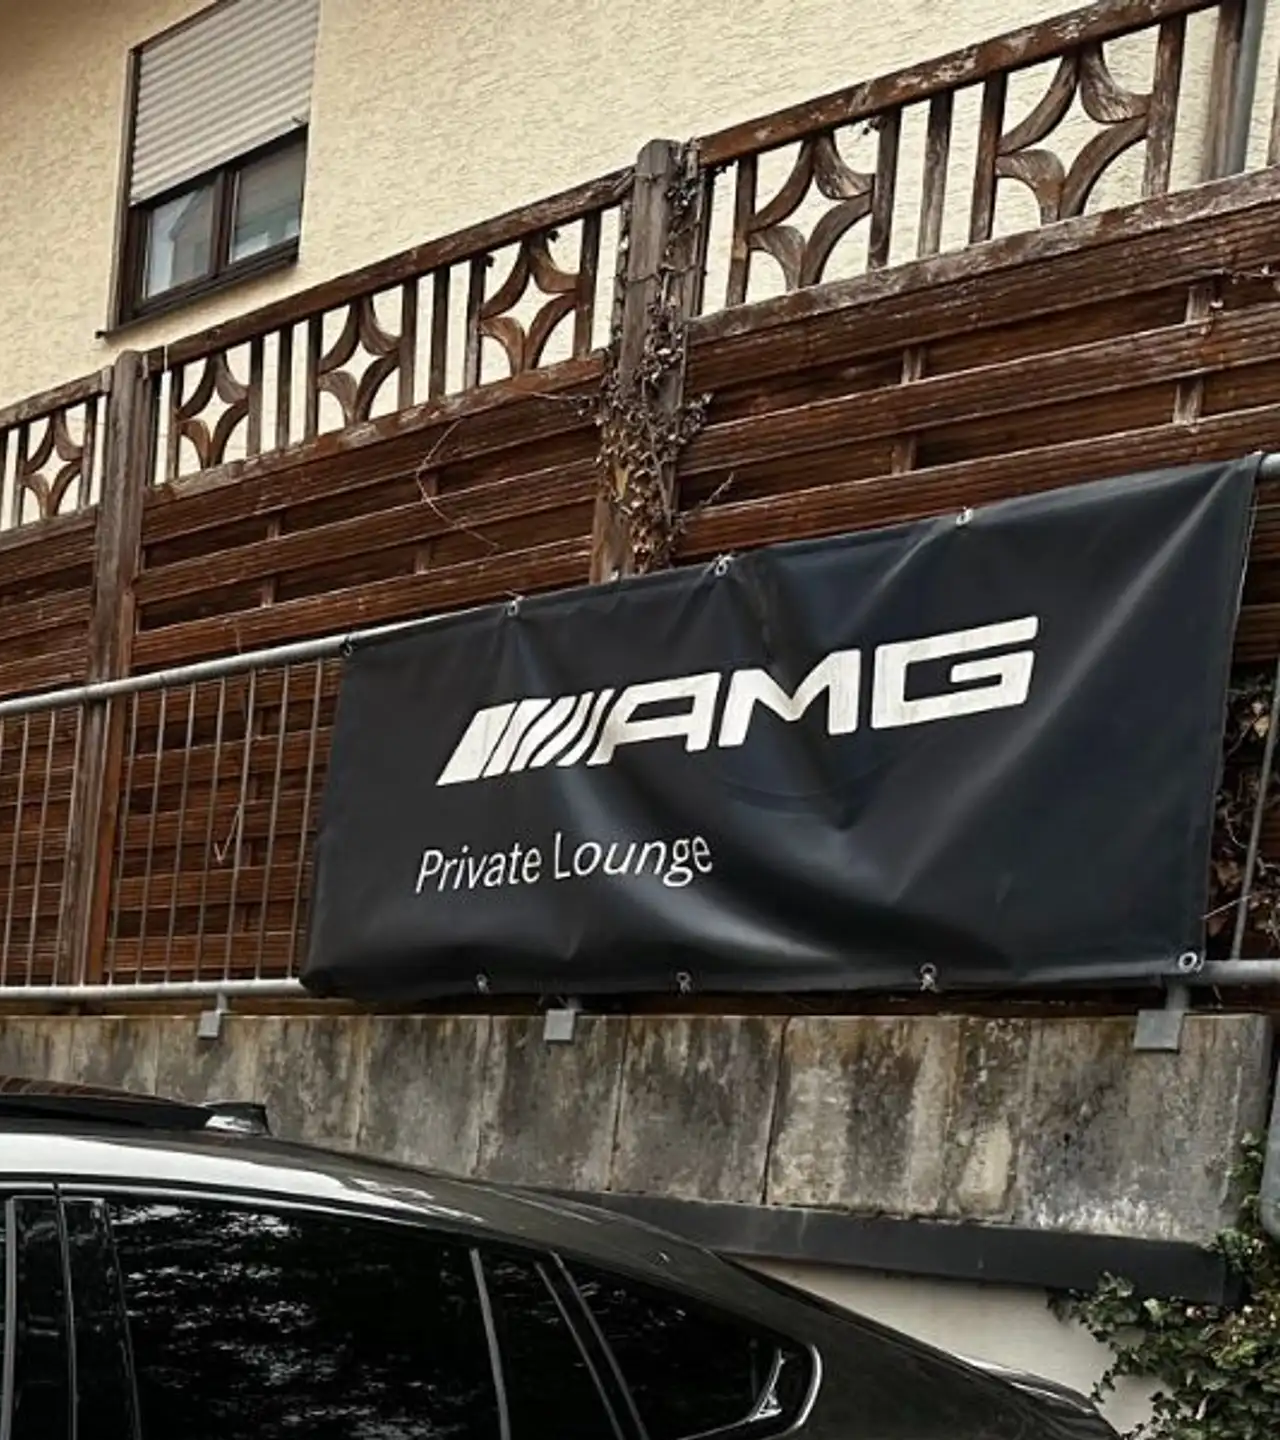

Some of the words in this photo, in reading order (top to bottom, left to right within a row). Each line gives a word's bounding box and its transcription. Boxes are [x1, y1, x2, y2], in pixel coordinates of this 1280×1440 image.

[588, 616, 1039, 767] AMG
[415, 842, 542, 894] Private
[554, 832, 713, 888] Lounge
